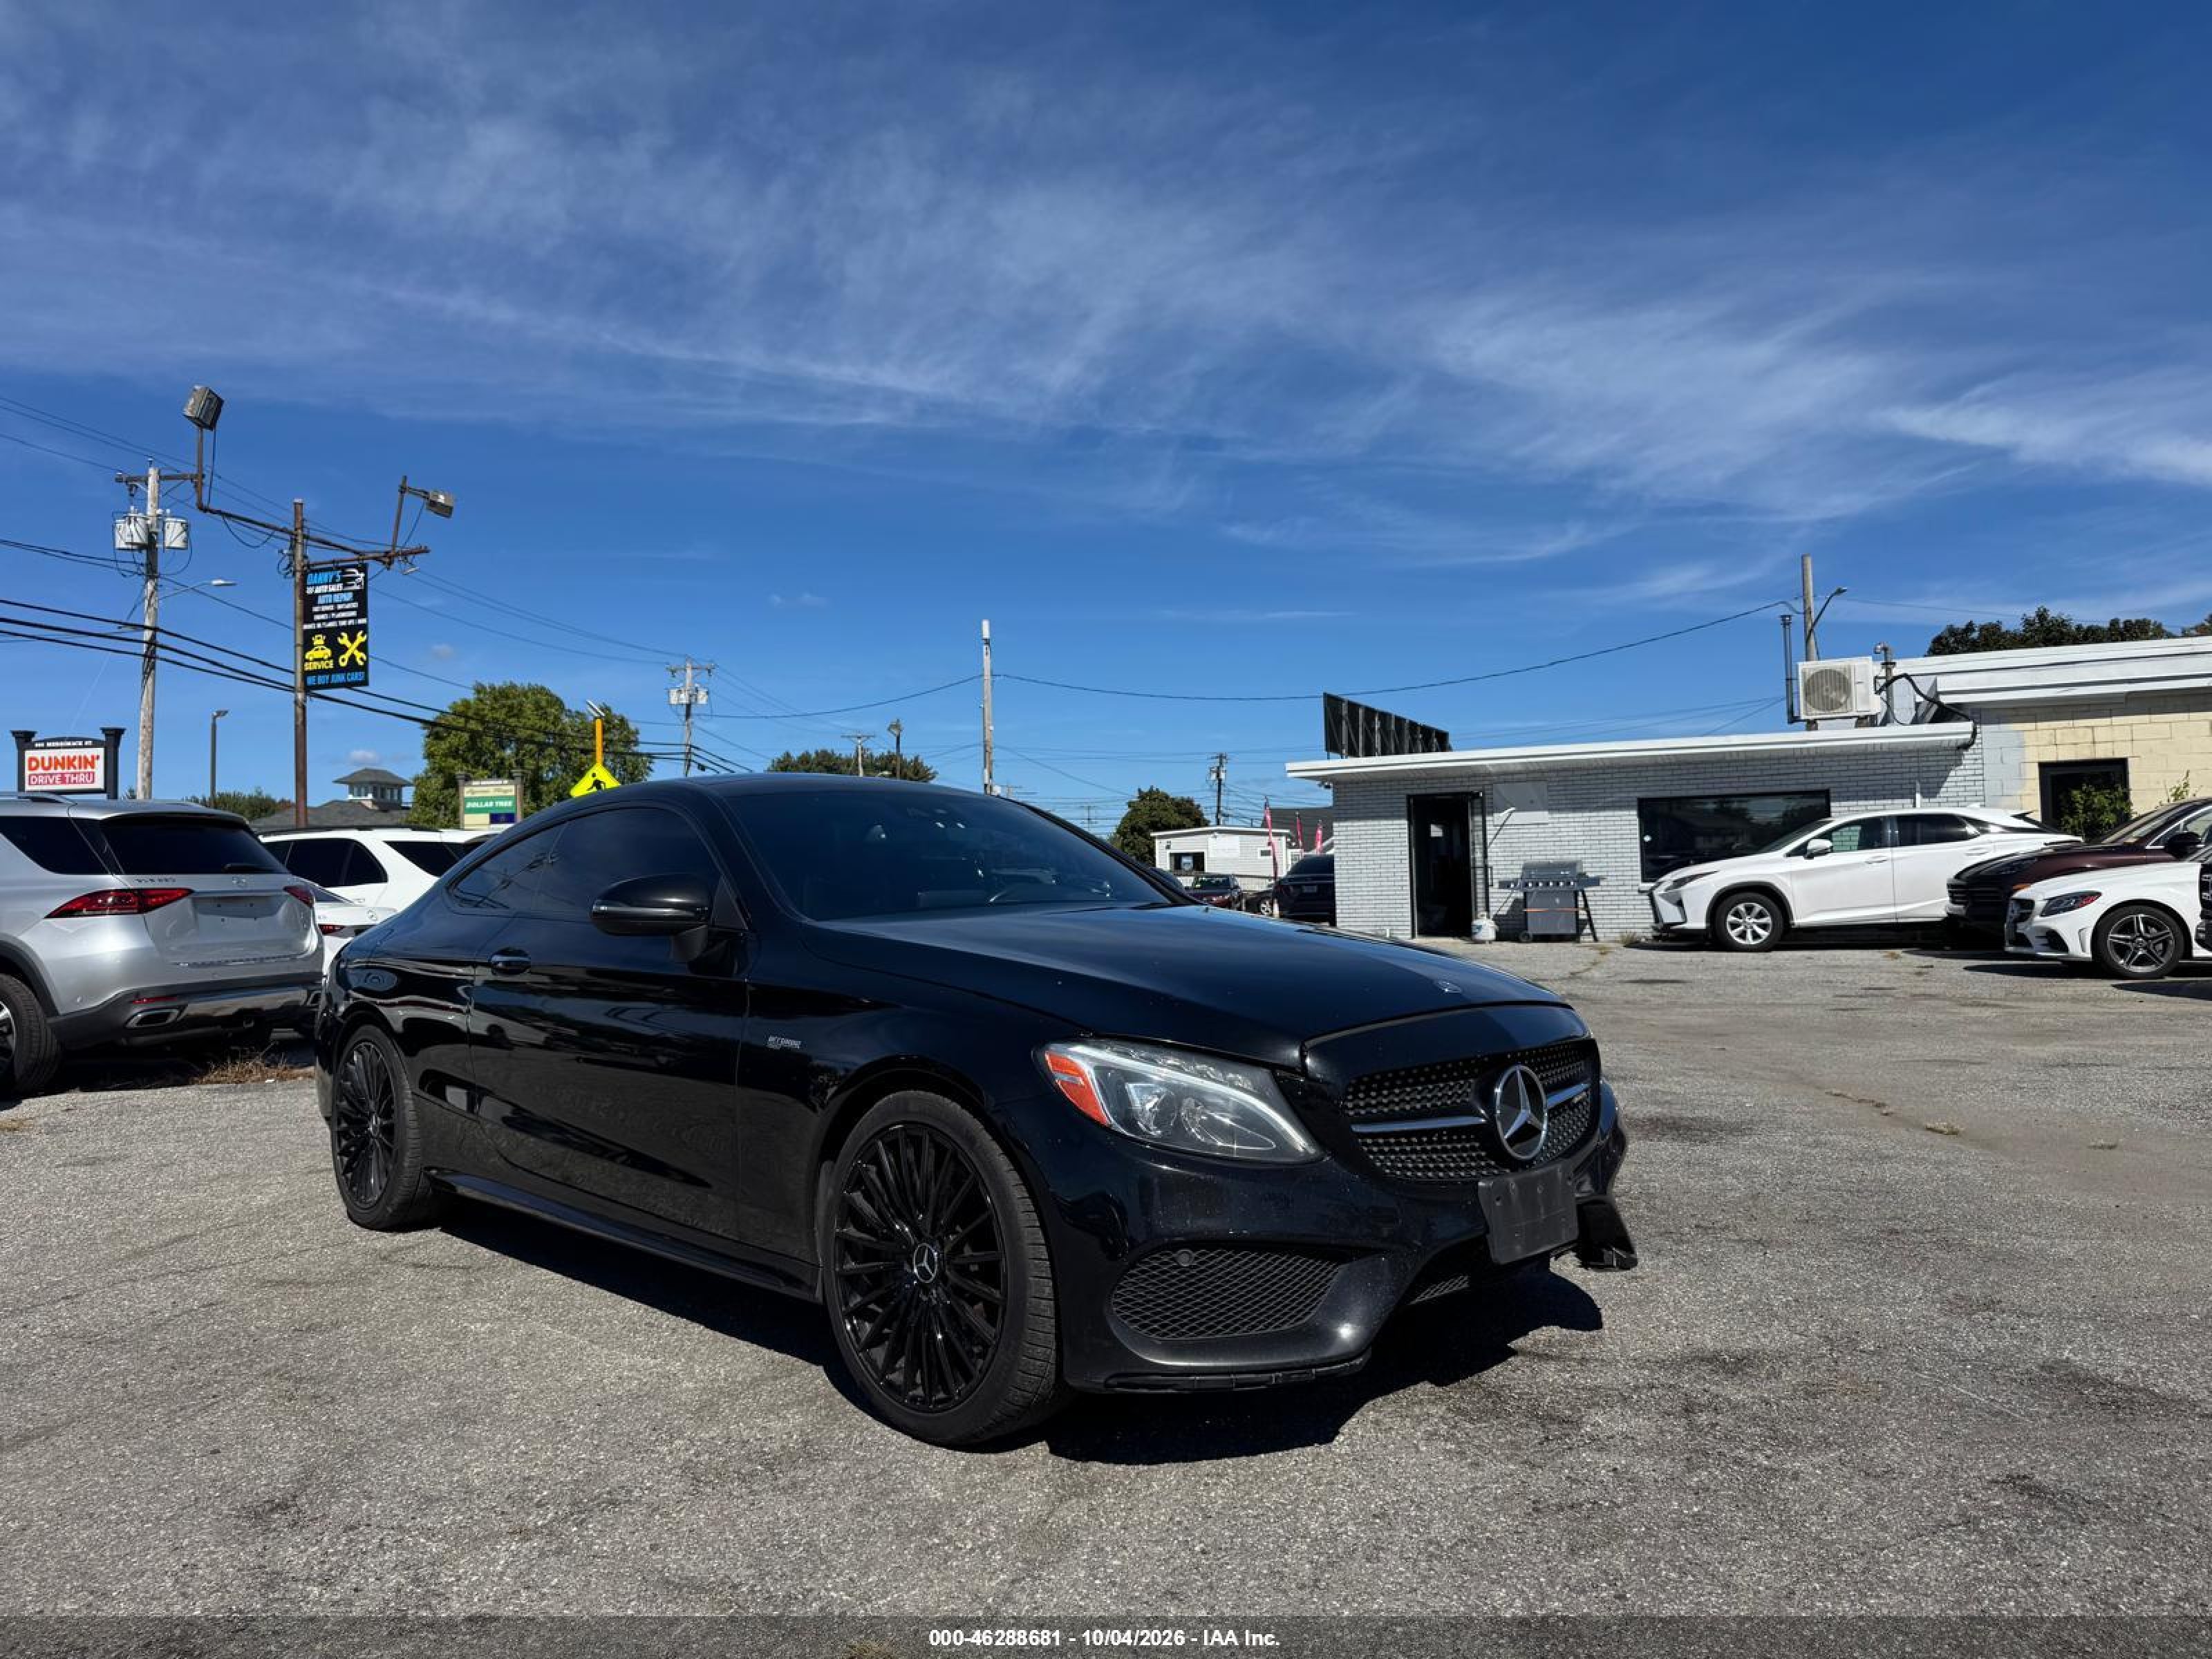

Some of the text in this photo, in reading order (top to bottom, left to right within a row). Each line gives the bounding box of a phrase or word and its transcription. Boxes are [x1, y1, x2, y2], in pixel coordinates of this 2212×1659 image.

[317, 593, 332, 604] AUTO
[304, 660, 333, 671] SERVICE
[306, 675, 317, 686] WE
[317, 675, 330, 684] BUY
[28, 754, 100, 771] DUNKIN'
[30, 773, 93, 785] DRIVE THRU
